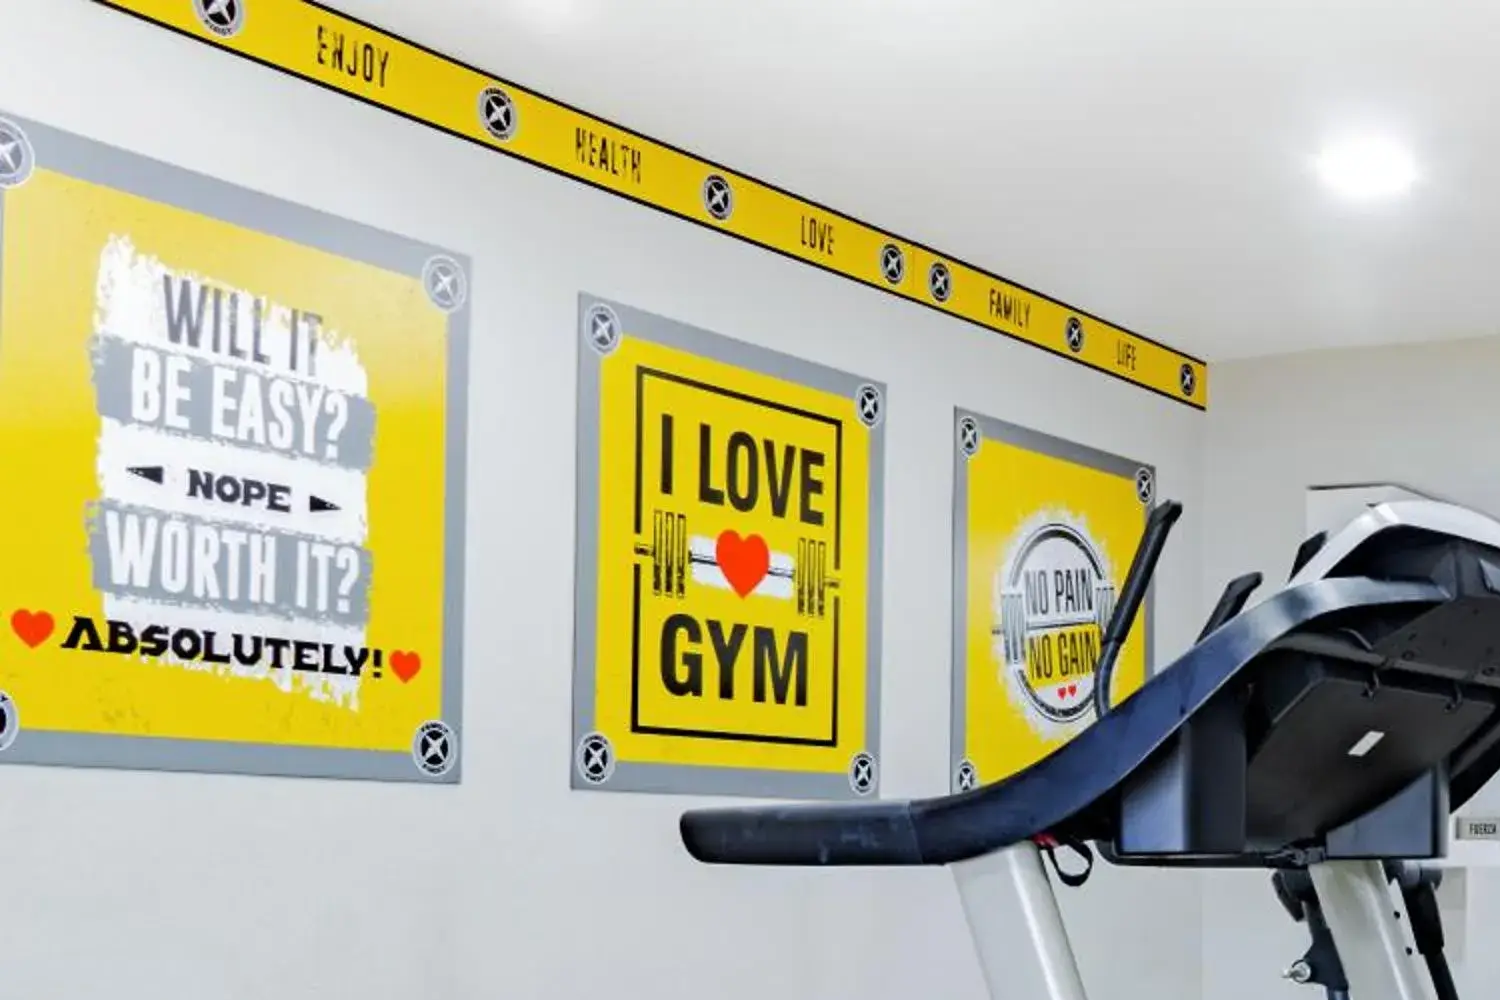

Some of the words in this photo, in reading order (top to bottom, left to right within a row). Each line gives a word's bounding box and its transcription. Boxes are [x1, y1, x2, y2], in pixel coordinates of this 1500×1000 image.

[316, 25, 389, 88] ENJOY
[575, 127, 642, 184] HEALTH
[801, 215, 835, 256] LOVE
[163, 274, 270, 364] WILL
[289, 308, 323, 377] IT
[989, 288, 1031, 329] FAMILY
[1116, 339, 1137, 371] LIFE
[131, 347, 191, 430] BE
[211, 363, 349, 460] EASY?
[187, 468, 292, 512] NOPE
[661, 413, 673, 495] I
[699, 422, 825, 527] LOVE
[105, 509, 277, 604] WORTH
[297, 540, 360, 614] IT?
[1024, 570, 1049, 615] NO
[1054, 569, 1093, 613] PAIN
[61, 615, 383, 679] ABSOLUTELY!
[660, 613, 809, 707] GYM
[1029, 634, 1053, 679] NO
[1058, 630, 1097, 677] GAIN
